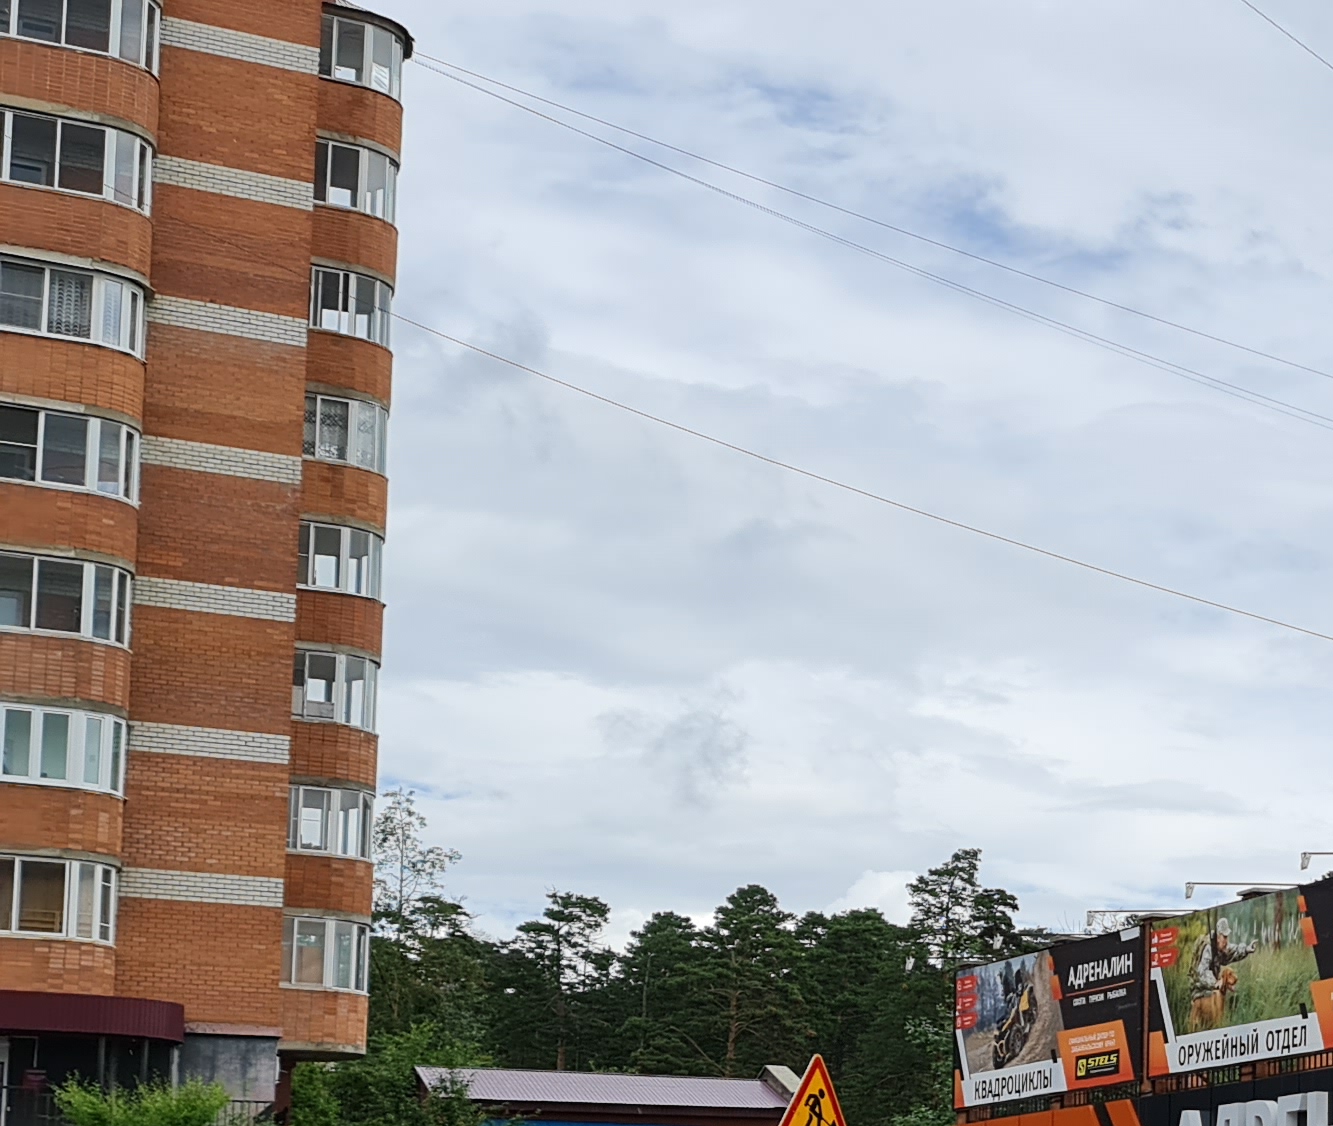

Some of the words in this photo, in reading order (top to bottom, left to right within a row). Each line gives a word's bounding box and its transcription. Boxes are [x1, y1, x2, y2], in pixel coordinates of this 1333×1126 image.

[1068, 953, 1133, 989] АДРЕНАЛИН
[1087, 1053, 1118, 1067] STELS
[1178, 1028, 1260, 1066] ОРУЖЕЙНЫЙ
[1265, 1025, 1307, 1054] ОТДЕЛ
[974, 1067, 1052, 1101] КВАДРОЦИКЛЫ
